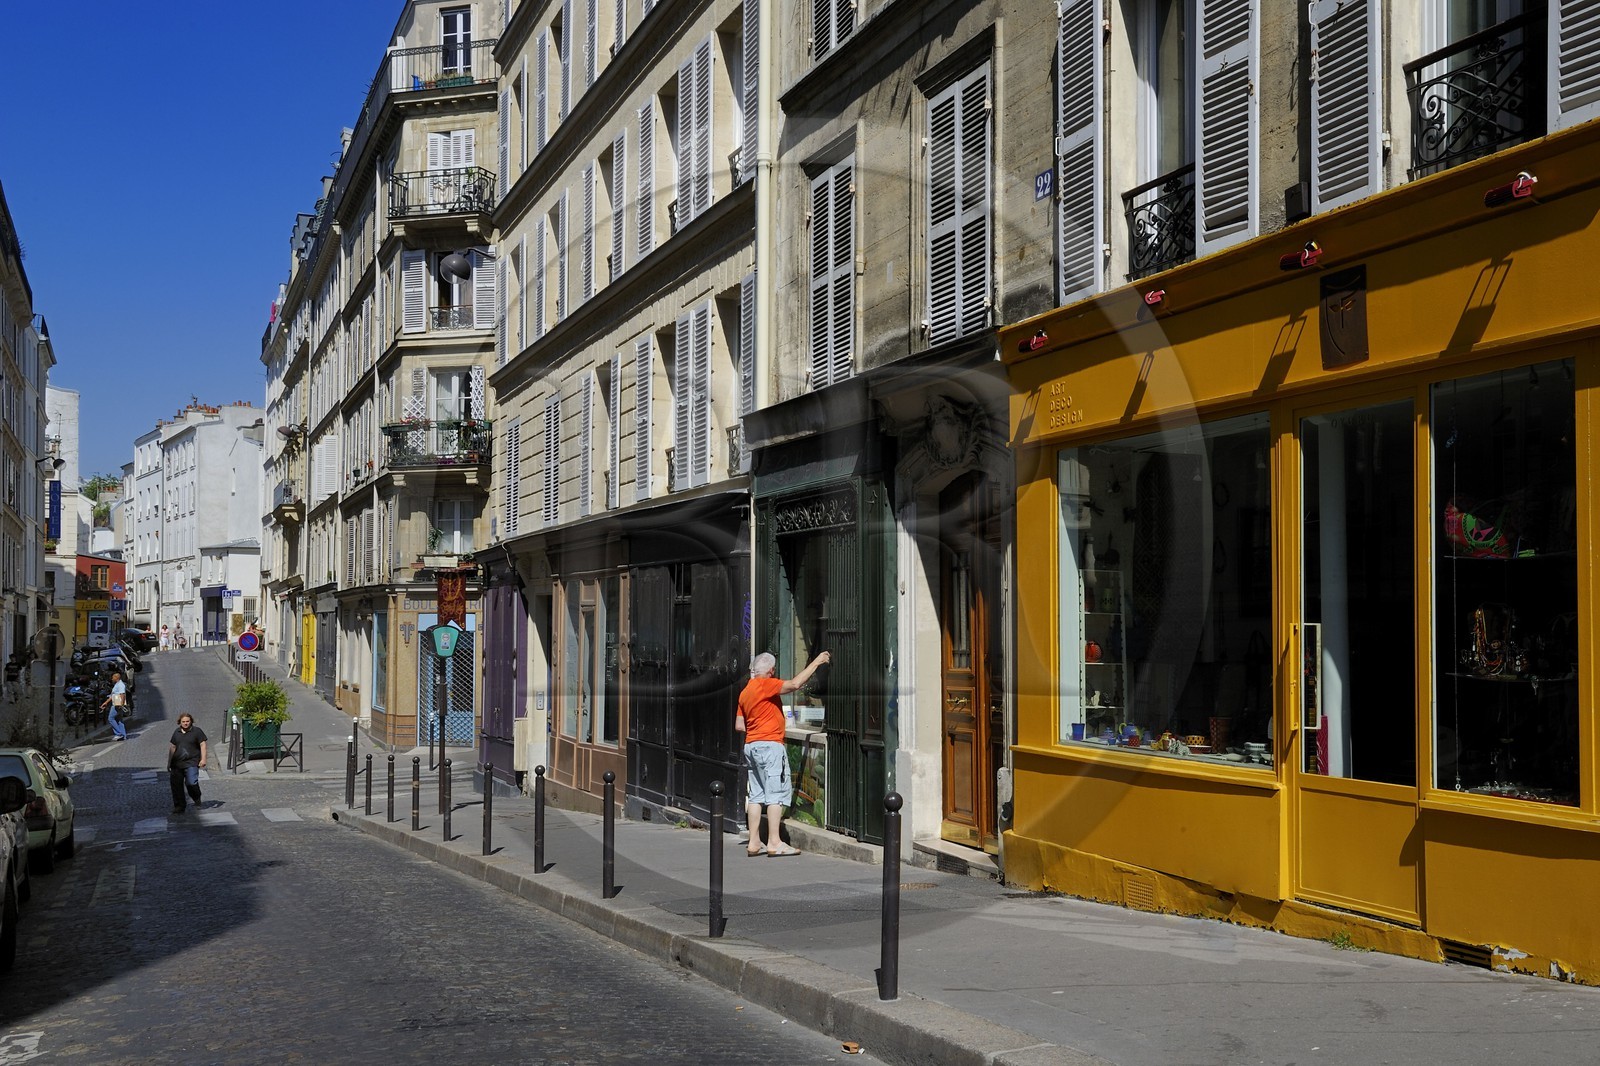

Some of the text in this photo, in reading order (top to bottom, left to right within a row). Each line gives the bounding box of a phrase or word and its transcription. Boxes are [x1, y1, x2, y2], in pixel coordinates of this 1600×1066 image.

[1036, 172, 1051, 199] 22
[1050, 381, 1066, 396] ART
[1050, 395, 1073, 413] DECO
[1050, 409, 1083, 429] DESIGN
[50, 482, 60, 536] HOTEL
[95, 620, 103, 631] P
